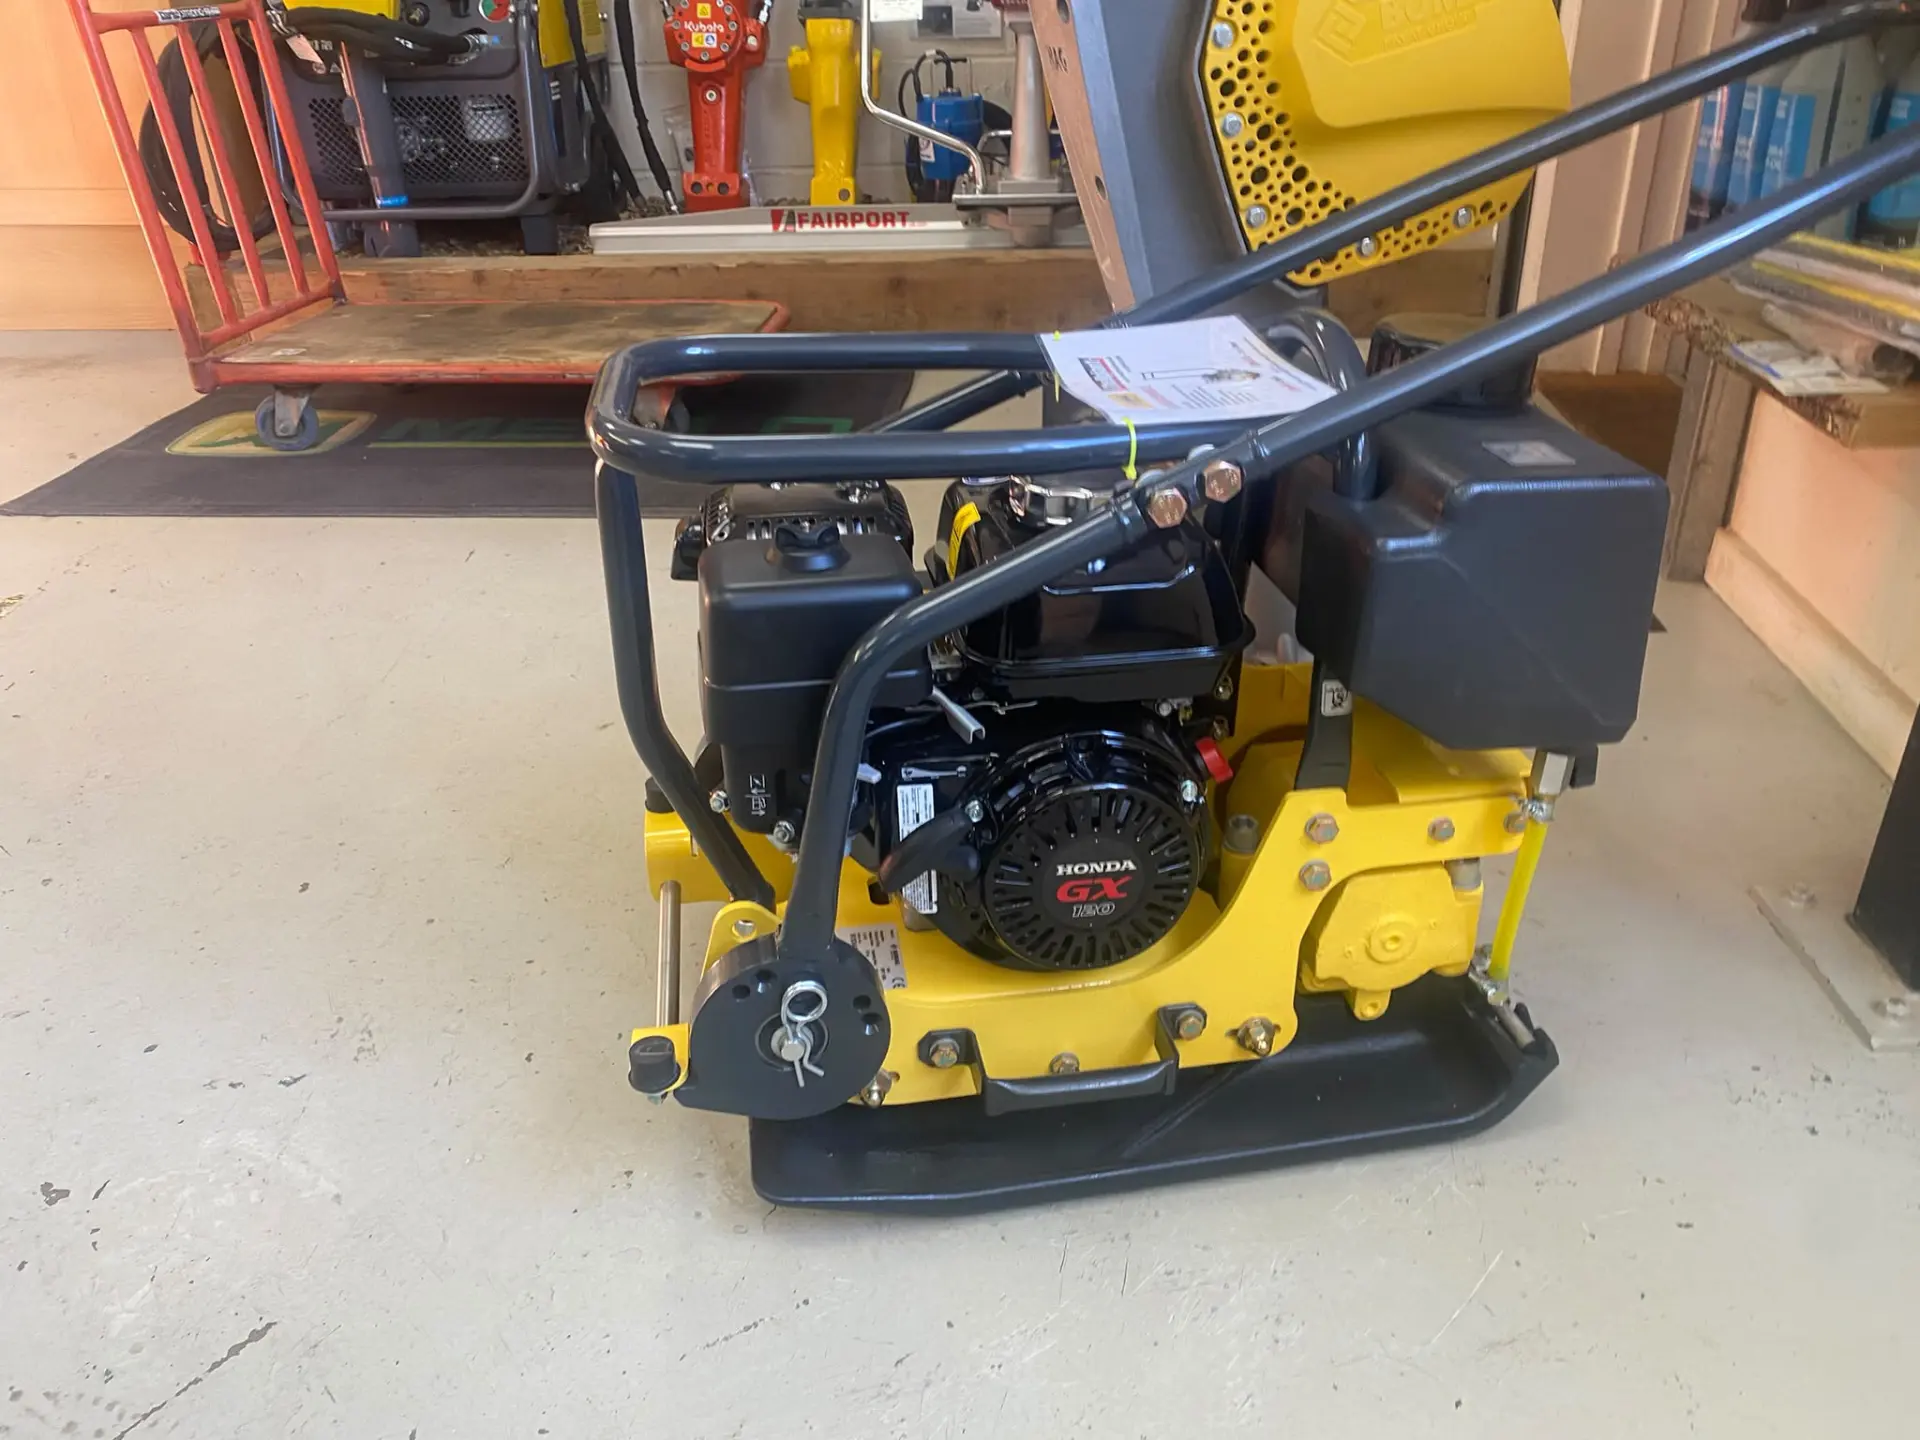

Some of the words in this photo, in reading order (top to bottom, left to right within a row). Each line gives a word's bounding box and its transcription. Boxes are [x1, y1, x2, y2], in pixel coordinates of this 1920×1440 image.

[683, 21, 725, 33] Kubota
[796, 210, 910, 229] FAIRPORT
[1055, 859, 1137, 876] HONDA
[1055, 875, 1132, 903] GX
[1072, 902, 1116, 918] 120
